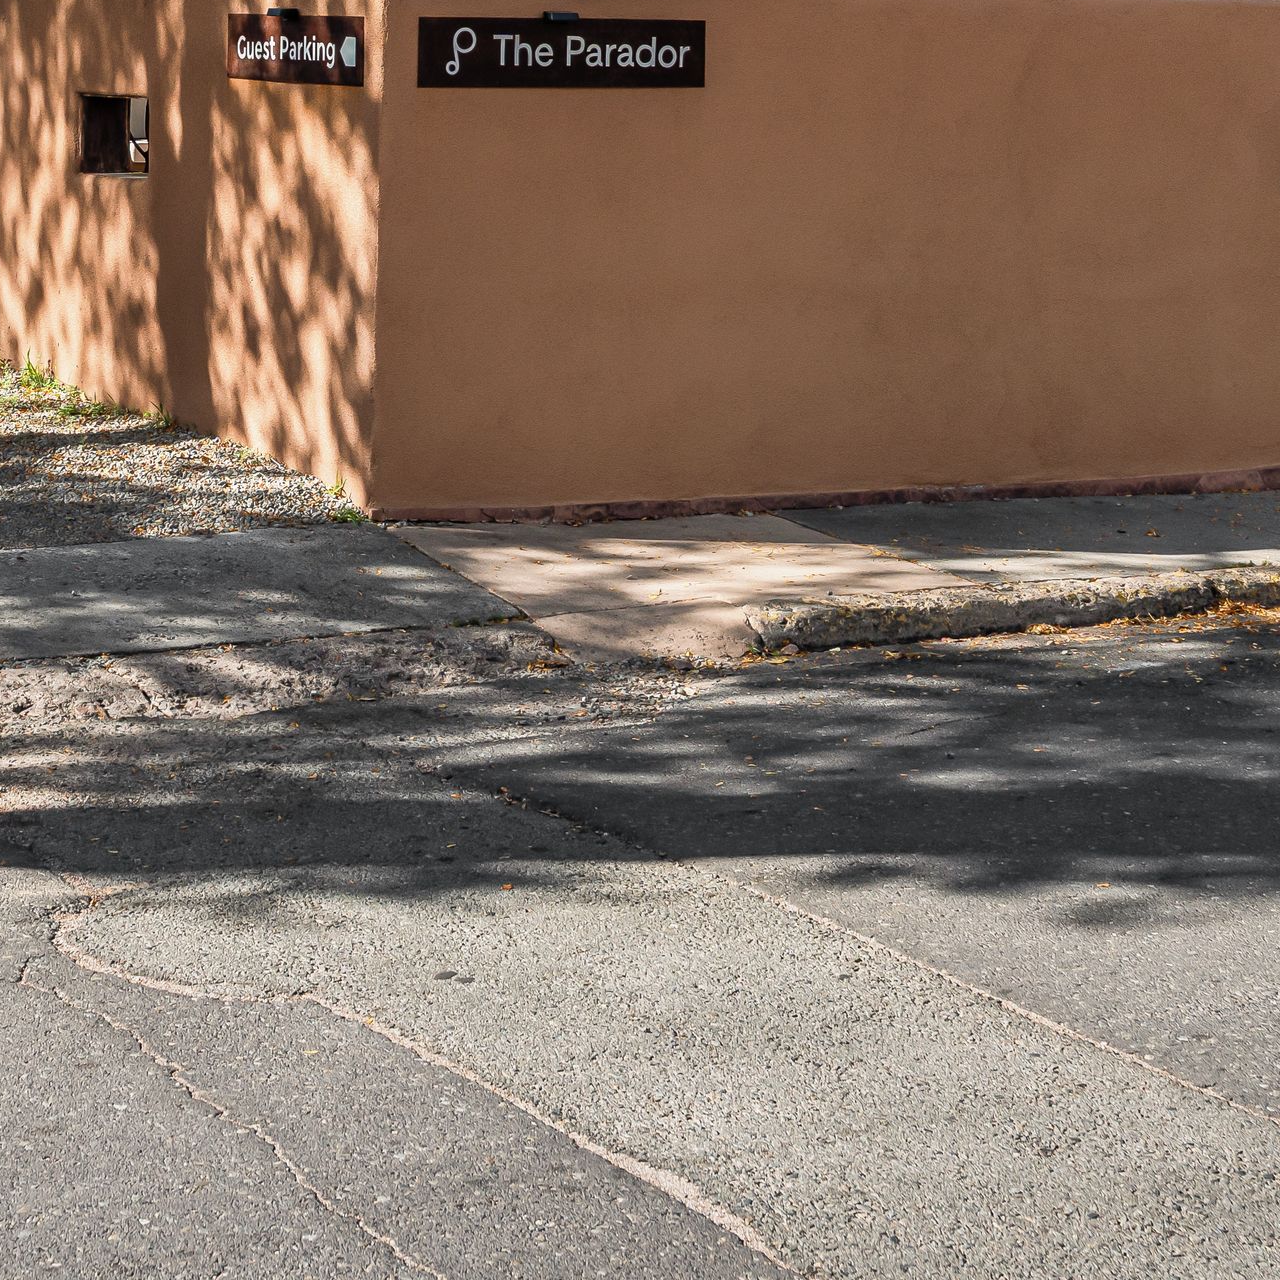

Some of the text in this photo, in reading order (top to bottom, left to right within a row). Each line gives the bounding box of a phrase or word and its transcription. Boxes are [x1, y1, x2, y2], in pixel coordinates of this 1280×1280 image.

[237, 35, 336, 69] Guest Parking
[493, 34, 691, 68] The Parador
